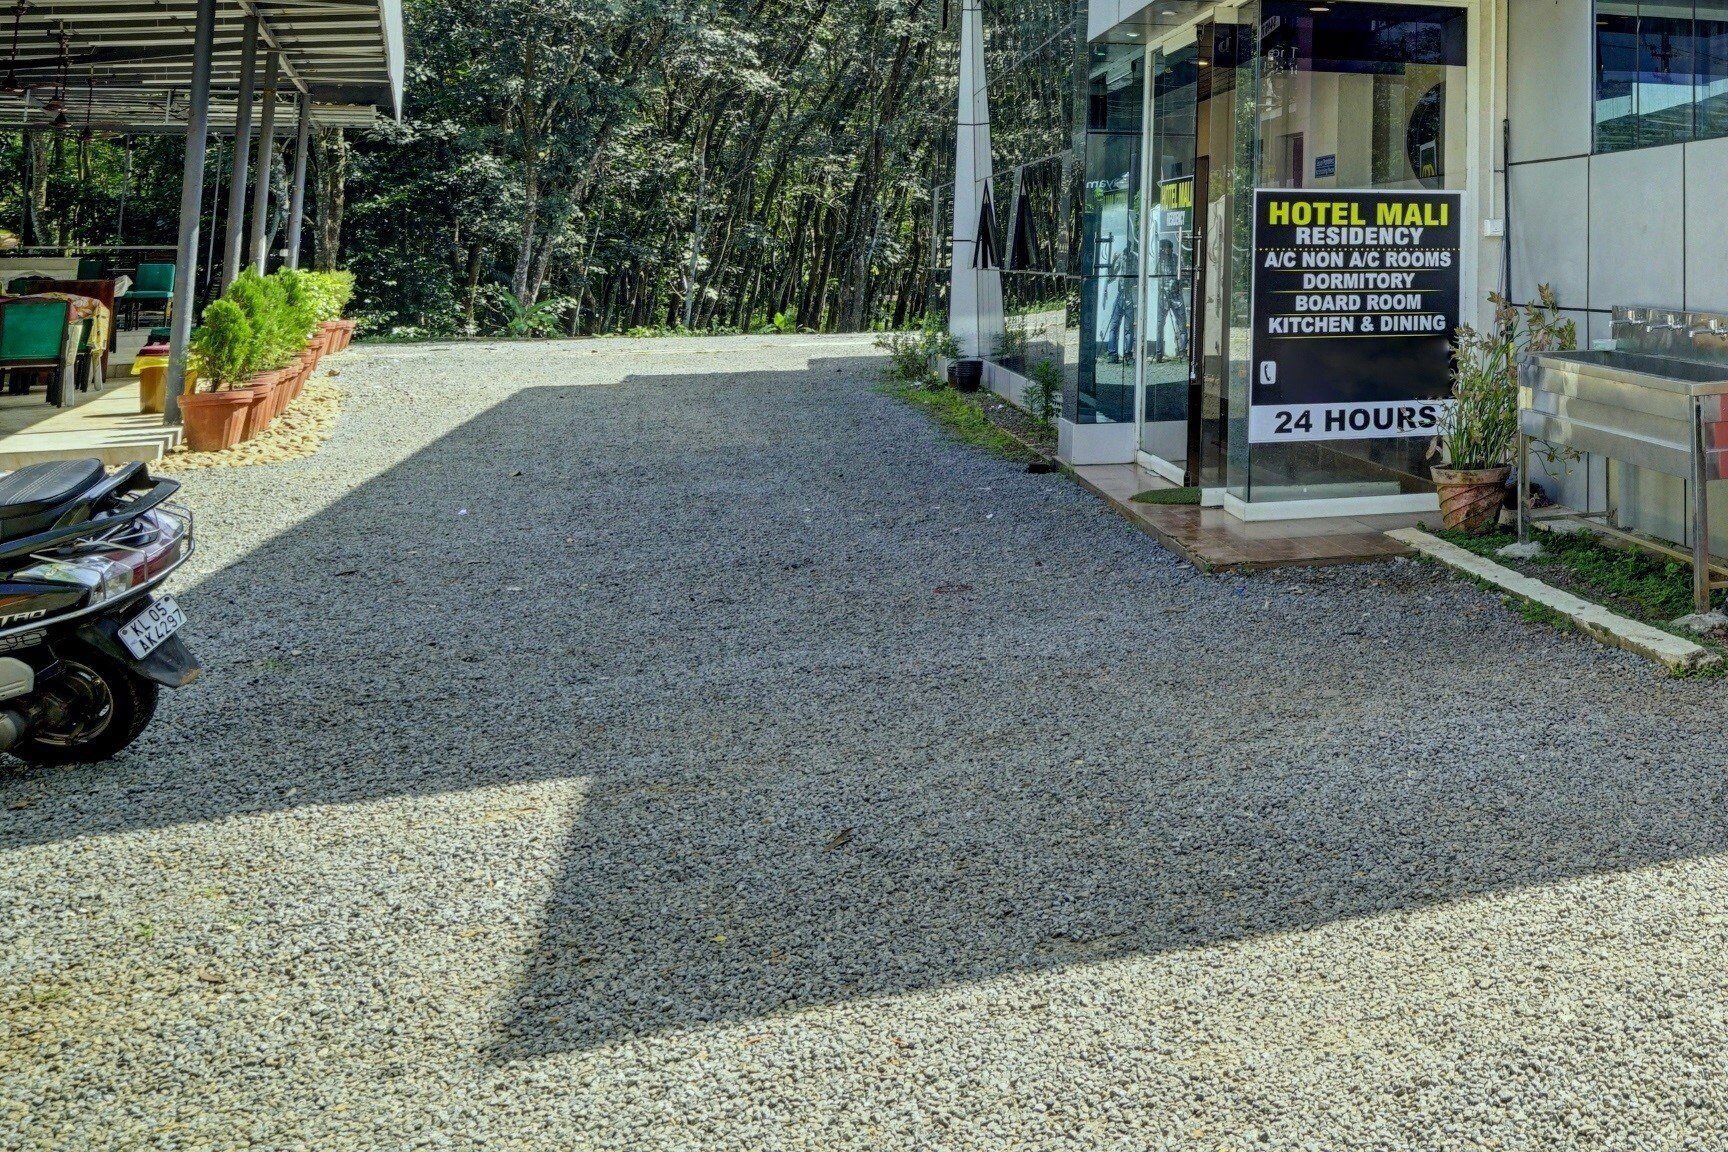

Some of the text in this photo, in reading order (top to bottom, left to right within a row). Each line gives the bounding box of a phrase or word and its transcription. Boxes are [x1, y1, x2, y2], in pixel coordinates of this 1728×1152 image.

[1269, 201, 1449, 226] HOTEL MALI
[1295, 226, 1424, 245] RESIDENCY
[1264, 251, 1451, 268] A/C NON A/C ROOMS
[1302, 272, 1416, 290] DORMITORY
[1295, 294, 1422, 311] BOARD ROOM
[1268, 314, 1446, 334] KITCHEN & DINING
[1274, 405, 1437, 434] 24 HOURS
[130, 602, 167, 636] KL 05
